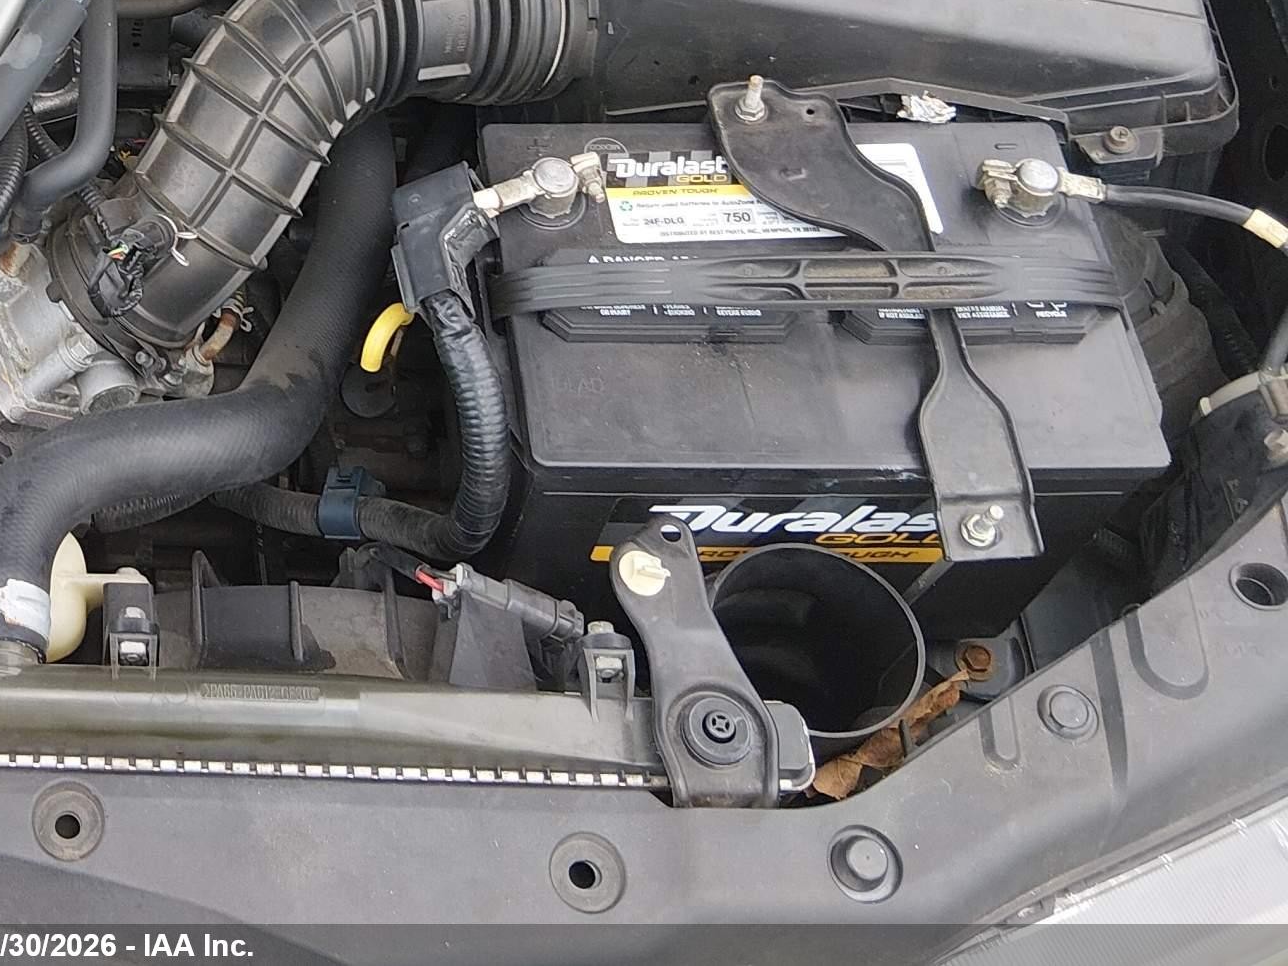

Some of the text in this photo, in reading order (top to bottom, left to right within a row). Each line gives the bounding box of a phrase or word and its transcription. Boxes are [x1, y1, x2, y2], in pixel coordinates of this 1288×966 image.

[609, 155, 729, 179] Duralast
[675, 174, 728, 184] GOLD
[681, 187, 719, 195] TOUGH
[723, 211, 751, 223] 750
[648, 504, 938, 533] Duralas
